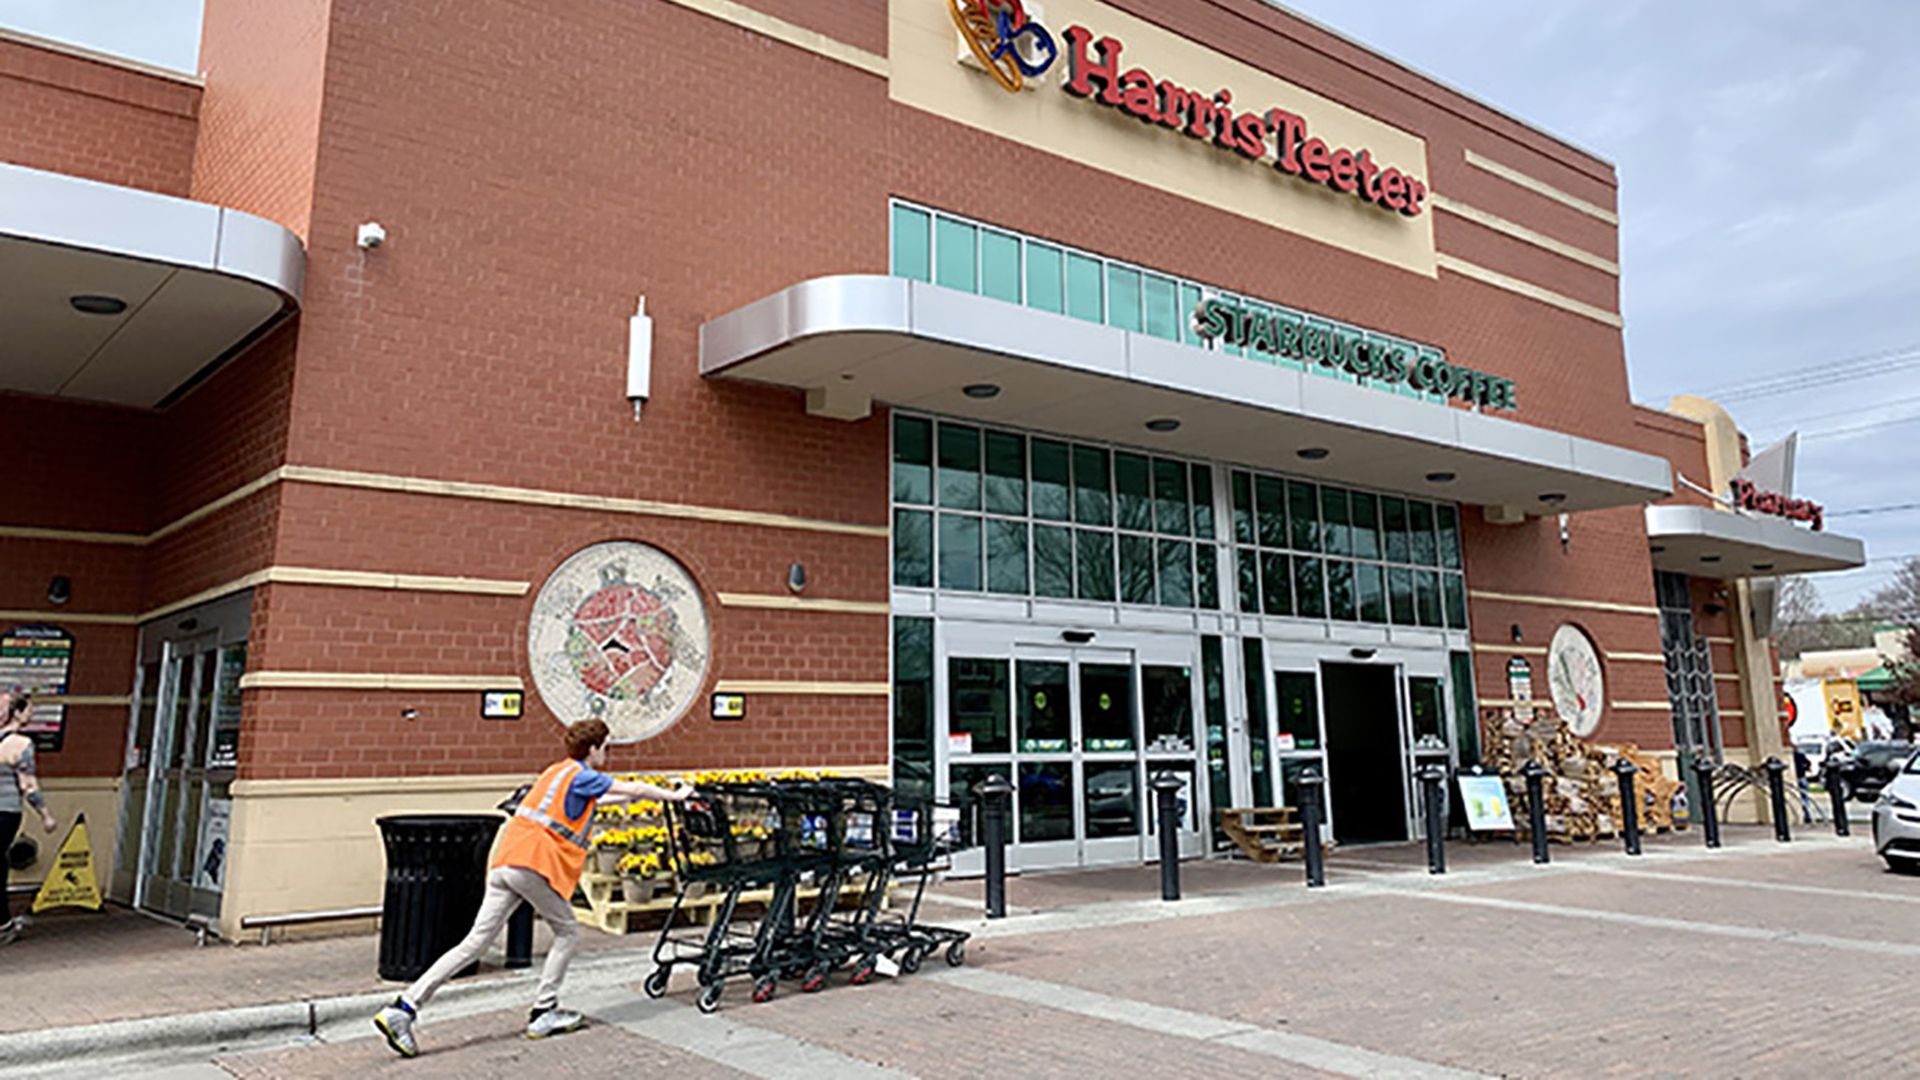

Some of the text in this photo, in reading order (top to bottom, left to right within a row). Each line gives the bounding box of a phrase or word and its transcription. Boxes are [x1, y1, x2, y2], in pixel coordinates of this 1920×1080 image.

[1063, 24, 1426, 216] Harris Teeter
[1198, 299, 1519, 410] STARBUCKS COFFEE
